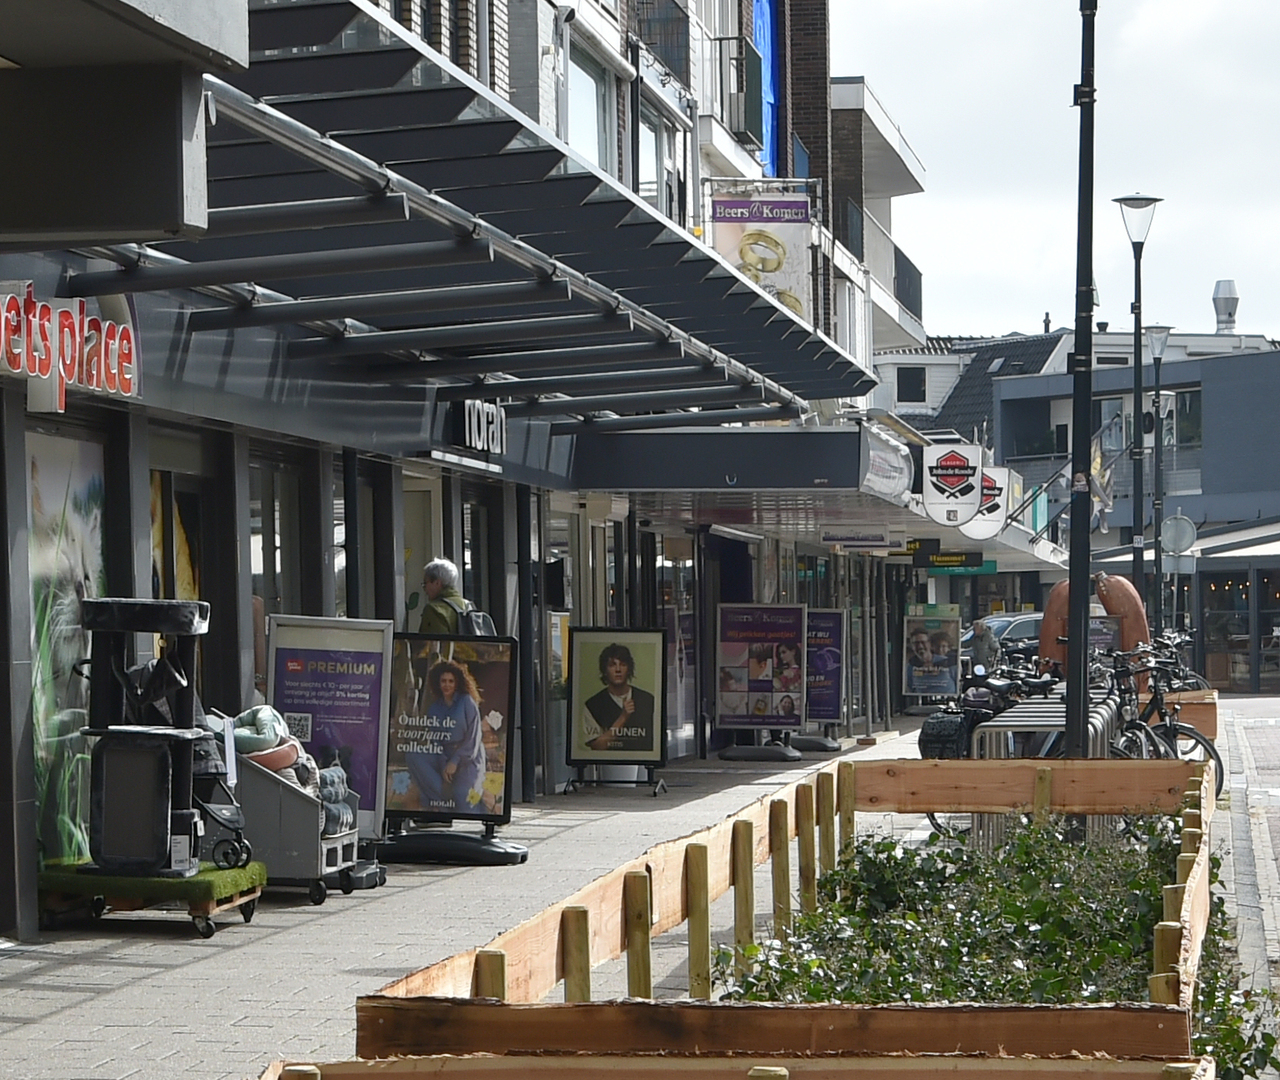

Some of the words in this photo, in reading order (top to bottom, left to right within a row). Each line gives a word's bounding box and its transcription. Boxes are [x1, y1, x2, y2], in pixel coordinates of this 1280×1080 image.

[716, 204, 749, 218] Beers
[762, 204, 806, 219] Komen
[57, 298, 133, 413] place
[464, 397, 507, 455] norah
[930, 554, 966, 562] Hummel
[308, 661, 376, 675] PREMIUM
[306, 698, 333, 706] volledige
[347, 692, 369, 700] korting
[398, 714, 440, 727] Ontdek
[442, 716, 456, 728] de
[397, 728, 452, 741] voorjaars
[397, 741, 444, 754] collectie
[430, 798, 456, 808] norah
